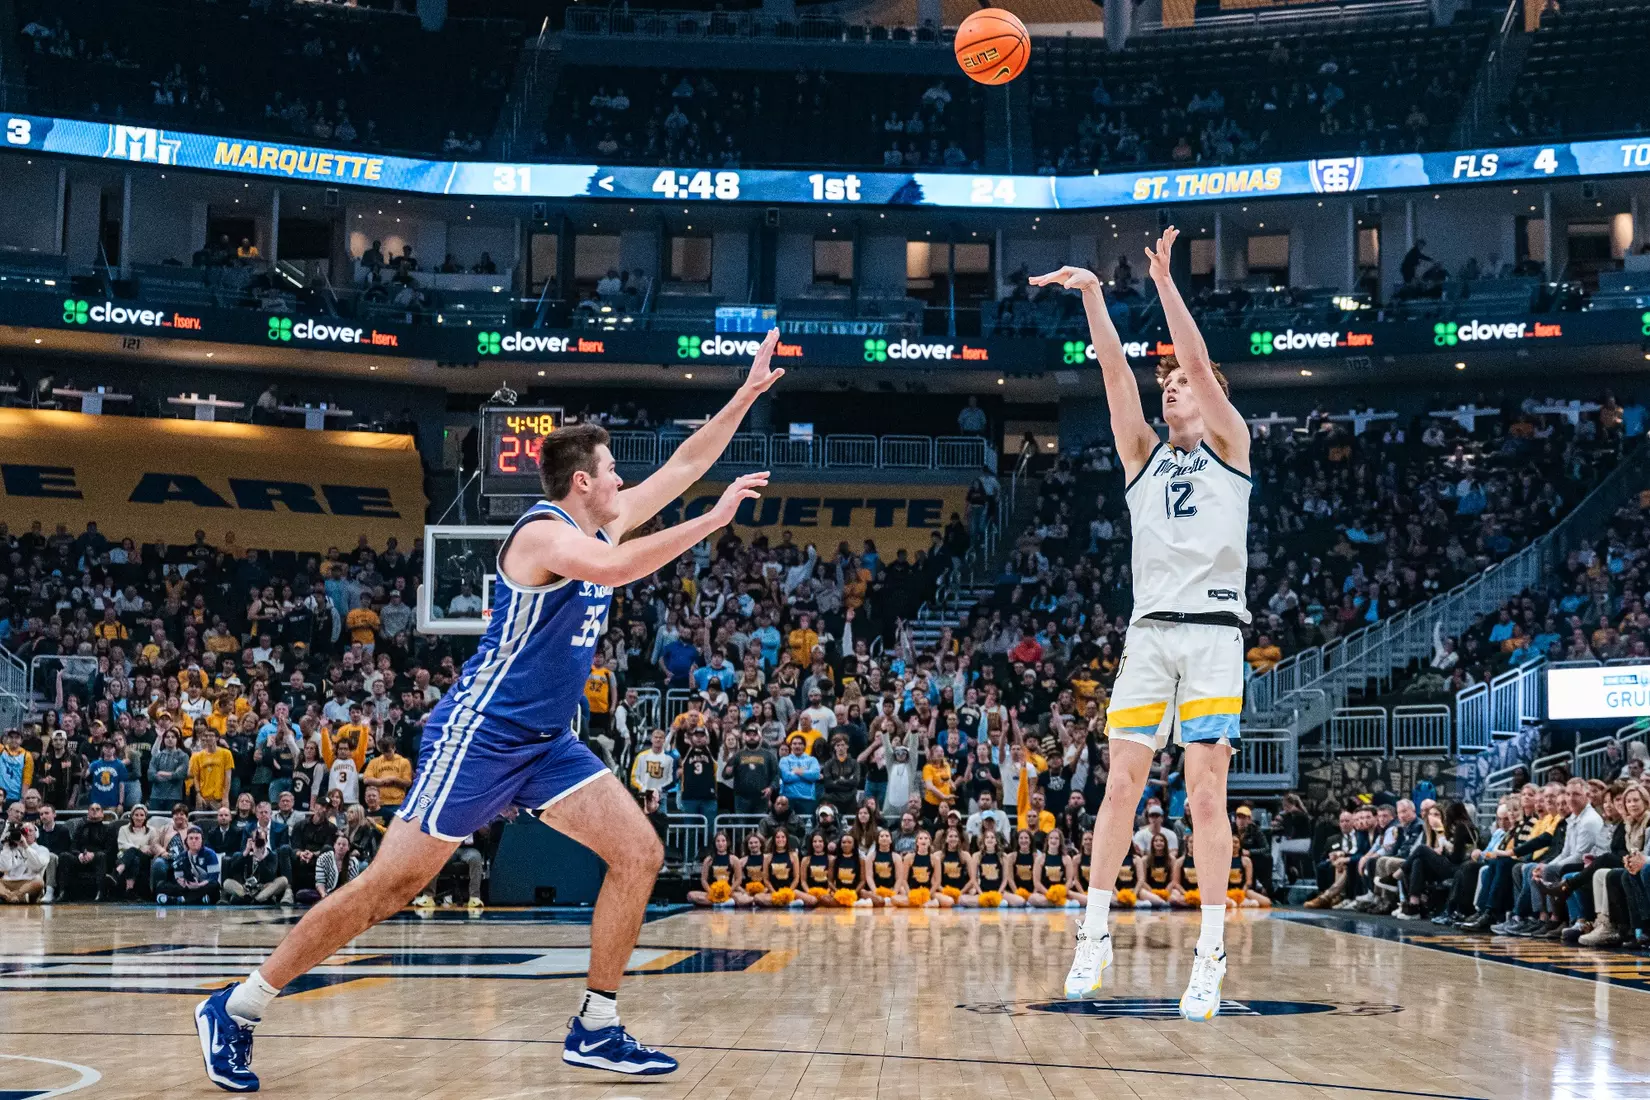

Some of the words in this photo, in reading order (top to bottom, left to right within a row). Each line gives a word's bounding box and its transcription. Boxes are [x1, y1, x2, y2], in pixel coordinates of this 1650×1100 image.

[963, 47, 1000, 69] ELITE
[7, 118, 32, 144] 3
[213, 142, 384, 180] MARQUETTE
[1452, 153, 1499, 178] FLS
[1533, 148, 1557, 174] 4
[492, 166, 530, 192] 31
[652, 170, 740, 200] 4:48
[808, 173, 861, 201] 1st
[1133, 176, 1170, 200] ST.
[1175, 167, 1281, 197] THOMAS
[970, 177, 1016, 205] 24
[90, 301, 164, 326] clover
[293, 318, 362, 343] clover
[501, 331, 569, 352] clover
[1273, 329, 1338, 350] clover
[1457, 319, 1526, 341] clover
[701, 335, 761, 355] clove
[887, 338, 953, 359] clover
[1085, 341, 1149, 360] cver
[506, 414, 553, 436] 4:48
[127, 472, 401, 519] ARE
[1165, 480, 1198, 519] 12
[338, 771, 348, 784] 3
[693, 762, 703, 775] 3
[293, 780, 304, 792] 3
